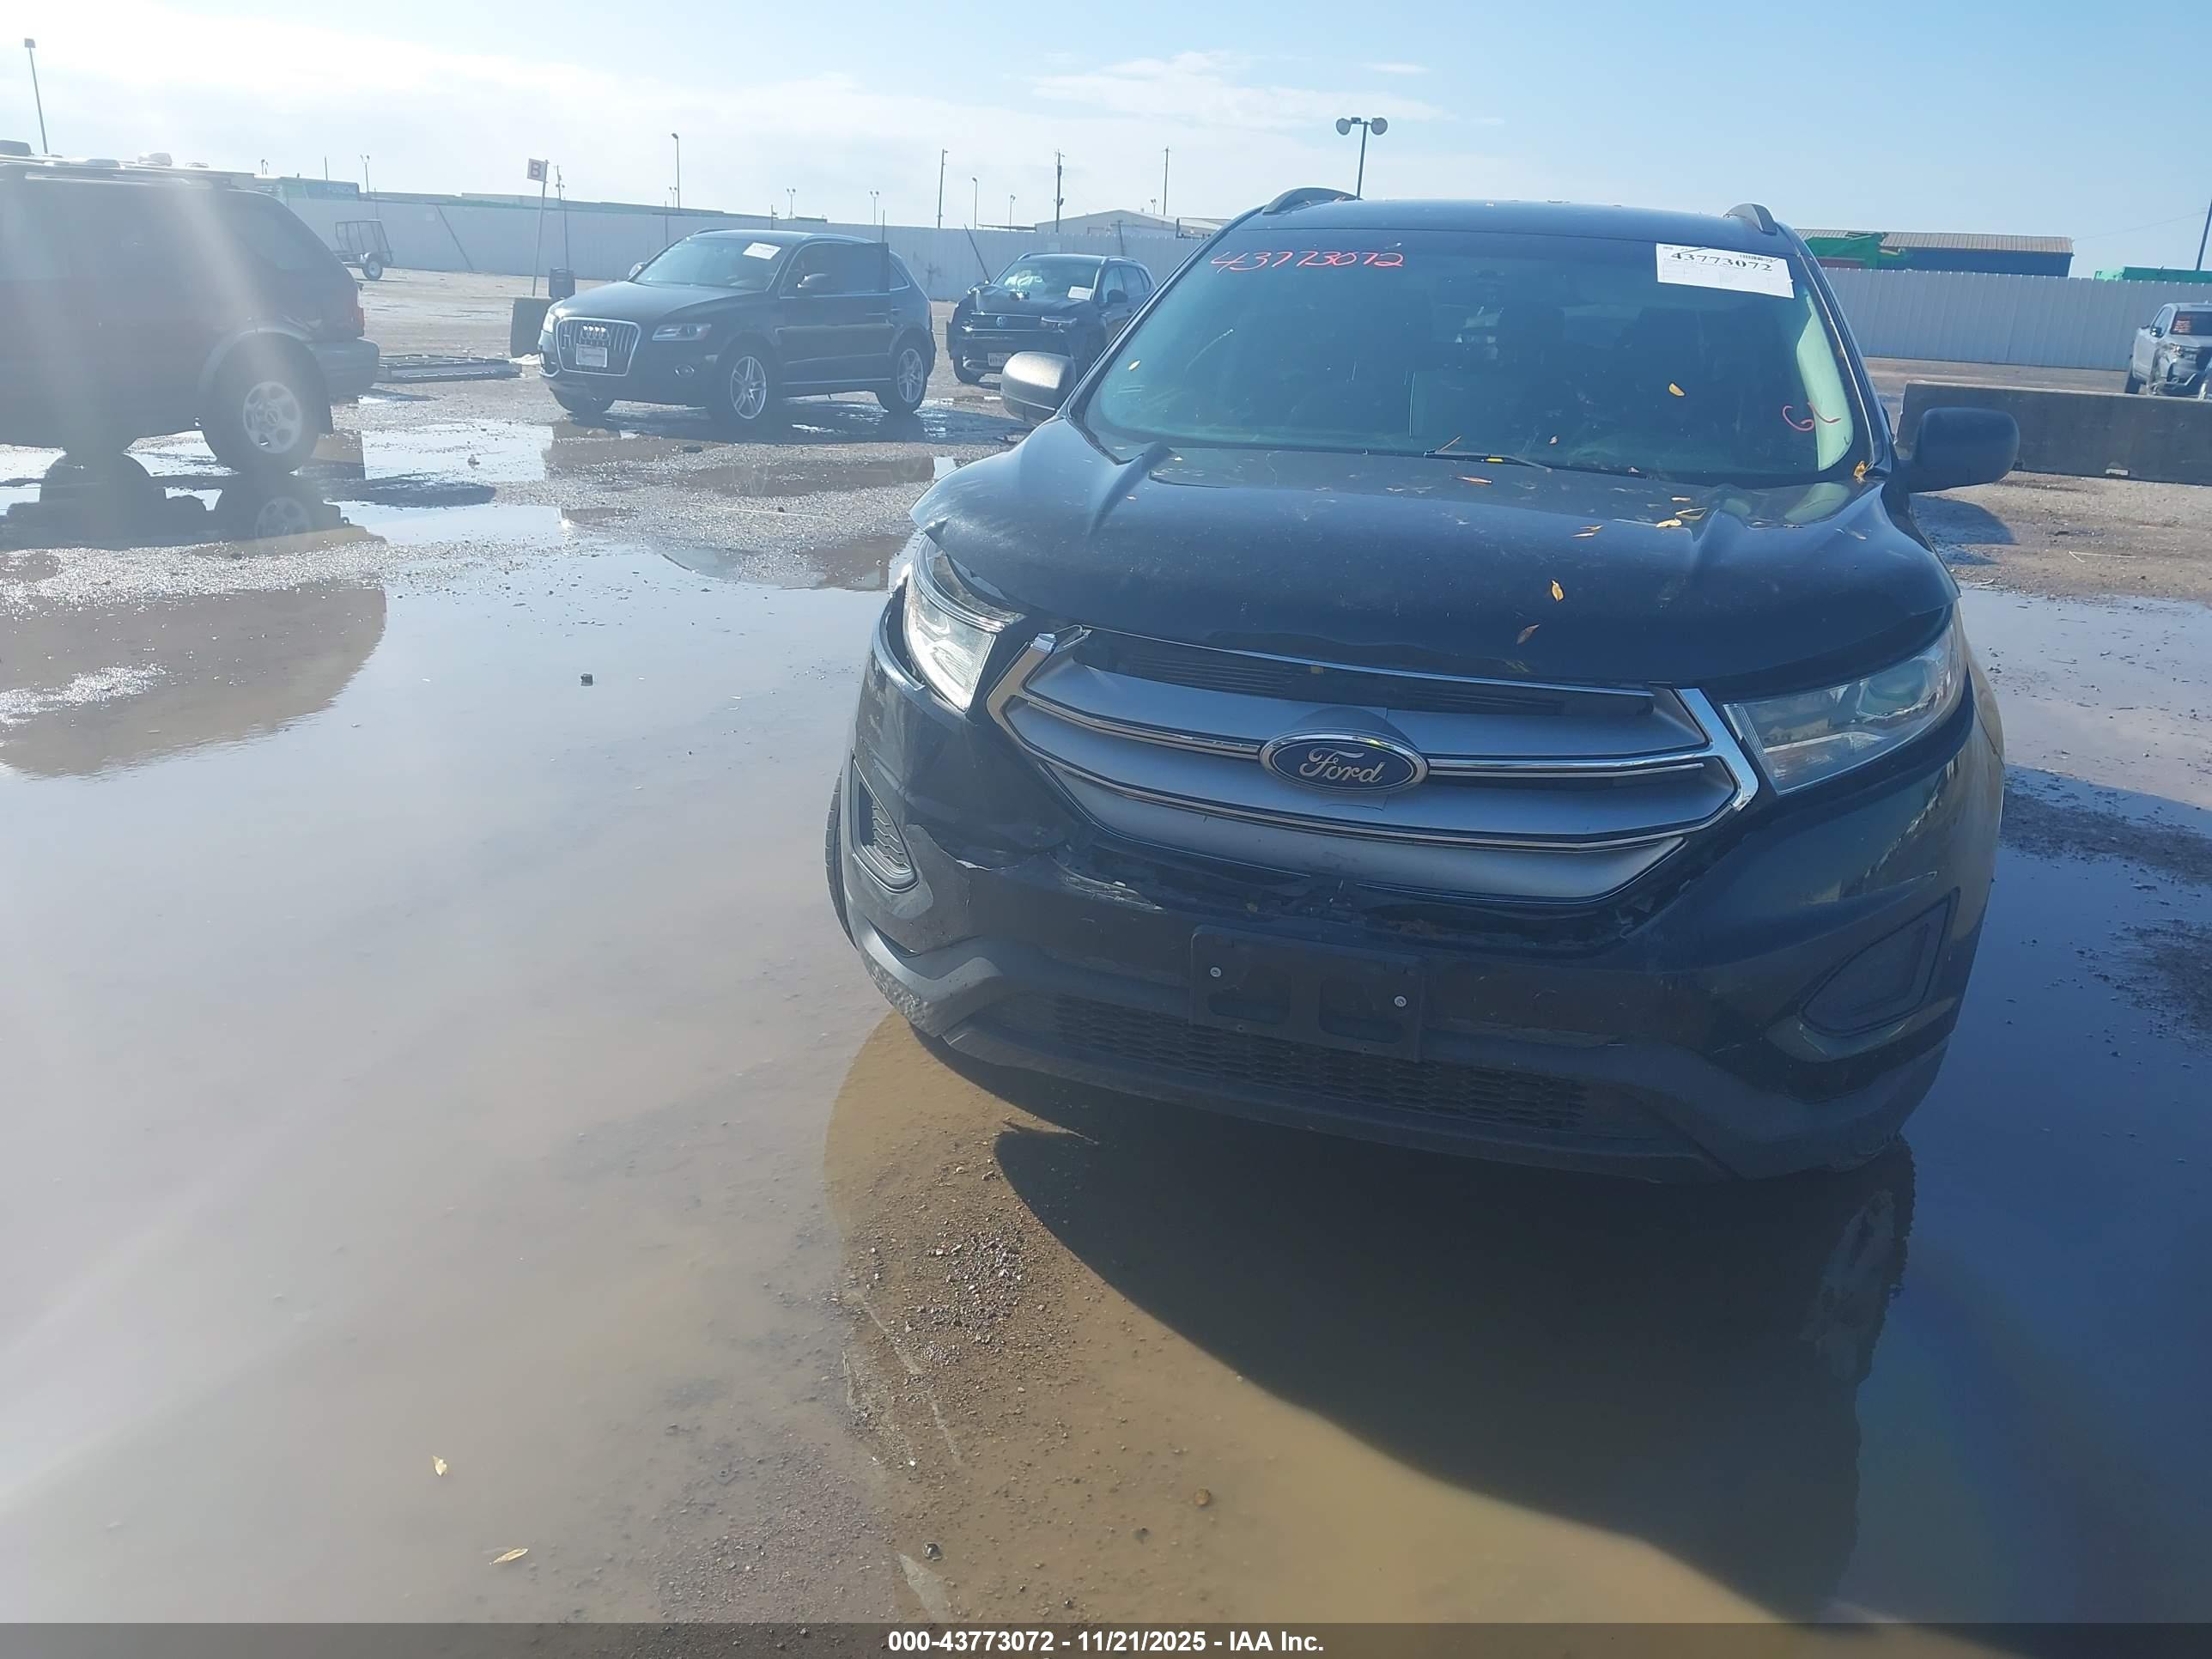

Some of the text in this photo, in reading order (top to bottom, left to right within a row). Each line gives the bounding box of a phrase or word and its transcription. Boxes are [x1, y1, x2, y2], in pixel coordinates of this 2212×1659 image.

[531, 162, 541, 178] B
[1211, 251, 1404, 274] 43773072
[1671, 252, 1773, 271] 43773072
[1298, 747, 1386, 783] Ford
